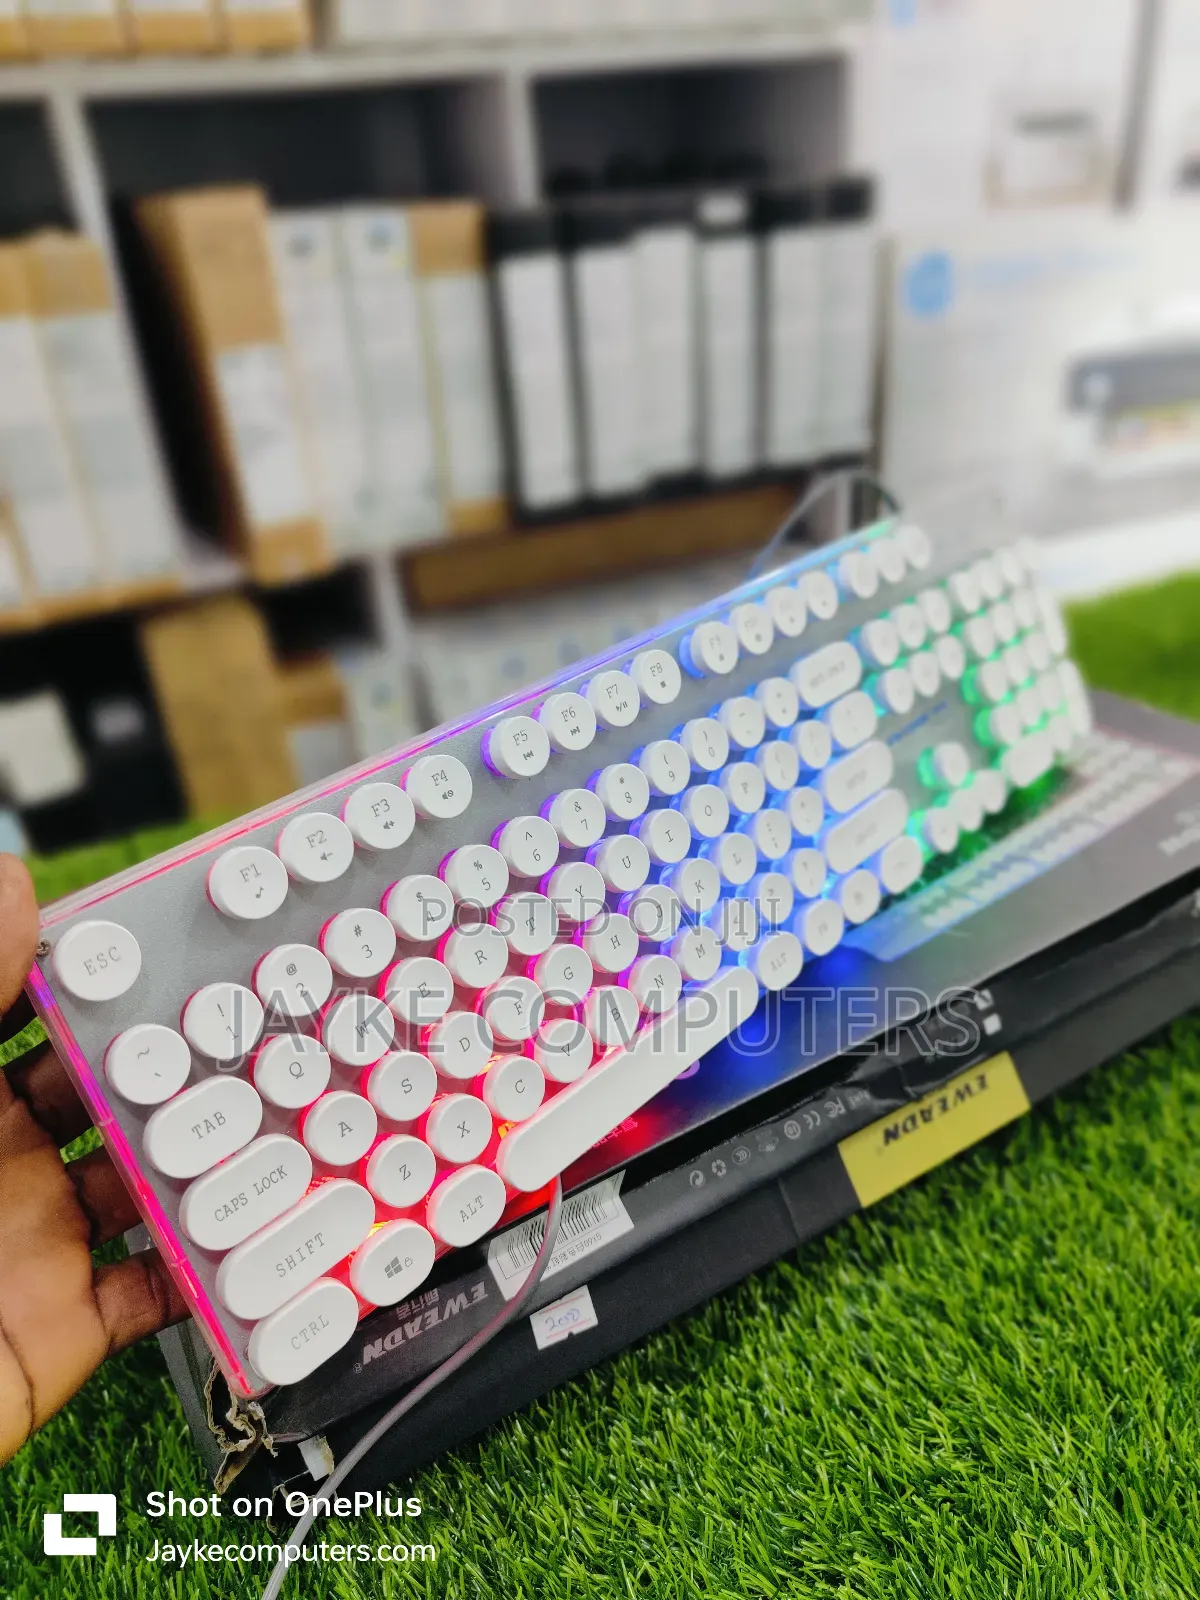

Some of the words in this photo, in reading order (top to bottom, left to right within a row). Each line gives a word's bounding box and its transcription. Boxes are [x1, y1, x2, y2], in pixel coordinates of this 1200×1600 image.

[650, 663, 662, 677] F8
[606, 684, 618, 698] F7
[561, 706, 576, 722] F6
[513, 730, 528, 746] F5
[431, 770, 448, 786] F4
[371, 799, 390, 817] F3
[574, 802, 582, 812] &
[306, 830, 327, 848] F2
[665, 830, 673, 842] I
[533, 849, 541, 861] 6
[622, 856, 631, 868] U
[733, 853, 742, 865] L
[240, 863, 261, 883] F1
[474, 860, 482, 871] %
[482, 878, 491, 890] 5
[695, 880, 704, 893] K
[416, 891, 424, 903] $
[574, 885, 585, 899] Y
[426, 910, 436, 922] 4
[655, 904, 664, 919] J
[354, 924, 362, 937] #
[525, 916, 537, 932] T
[611, 935, 621, 949] H
[362, 945, 372, 958] 3
[474, 950, 487, 965] R
[696, 944, 705, 958] M
[83, 946, 120, 976] ESC
[286, 963, 297, 975] @
[564, 966, 573, 980] G
[654, 974, 664, 989] N
[295, 982, 309, 998] 2
[417, 982, 431, 999] E
[513, 1000, 524, 1016] F
[610, 1008, 621, 1022] B
[226, 1025, 239, 1041] 1
[354, 1021, 371, 1039] W
[459, 1037, 470, 1052] D
[560, 1044, 571, 1057] V
[289, 1062, 304, 1079] Q
[401, 1078, 412, 1094] S
[515, 1079, 525, 1093] C
[884, 1073, 988, 1146] EWEADN
[191, 1112, 225, 1139] TAB
[338, 1121, 353, 1137] A
[457, 1121, 470, 1138] X
[399, 1164, 411, 1180] Z
[215, 1192, 248, 1221] CAPS
[253, 1165, 287, 1195] LOCK
[460, 1196, 484, 1222] ALT
[275, 1232, 326, 1278] SHIFT
[363, 1281, 488, 1365] EWEADN
[291, 1315, 329, 1349] CTRL
